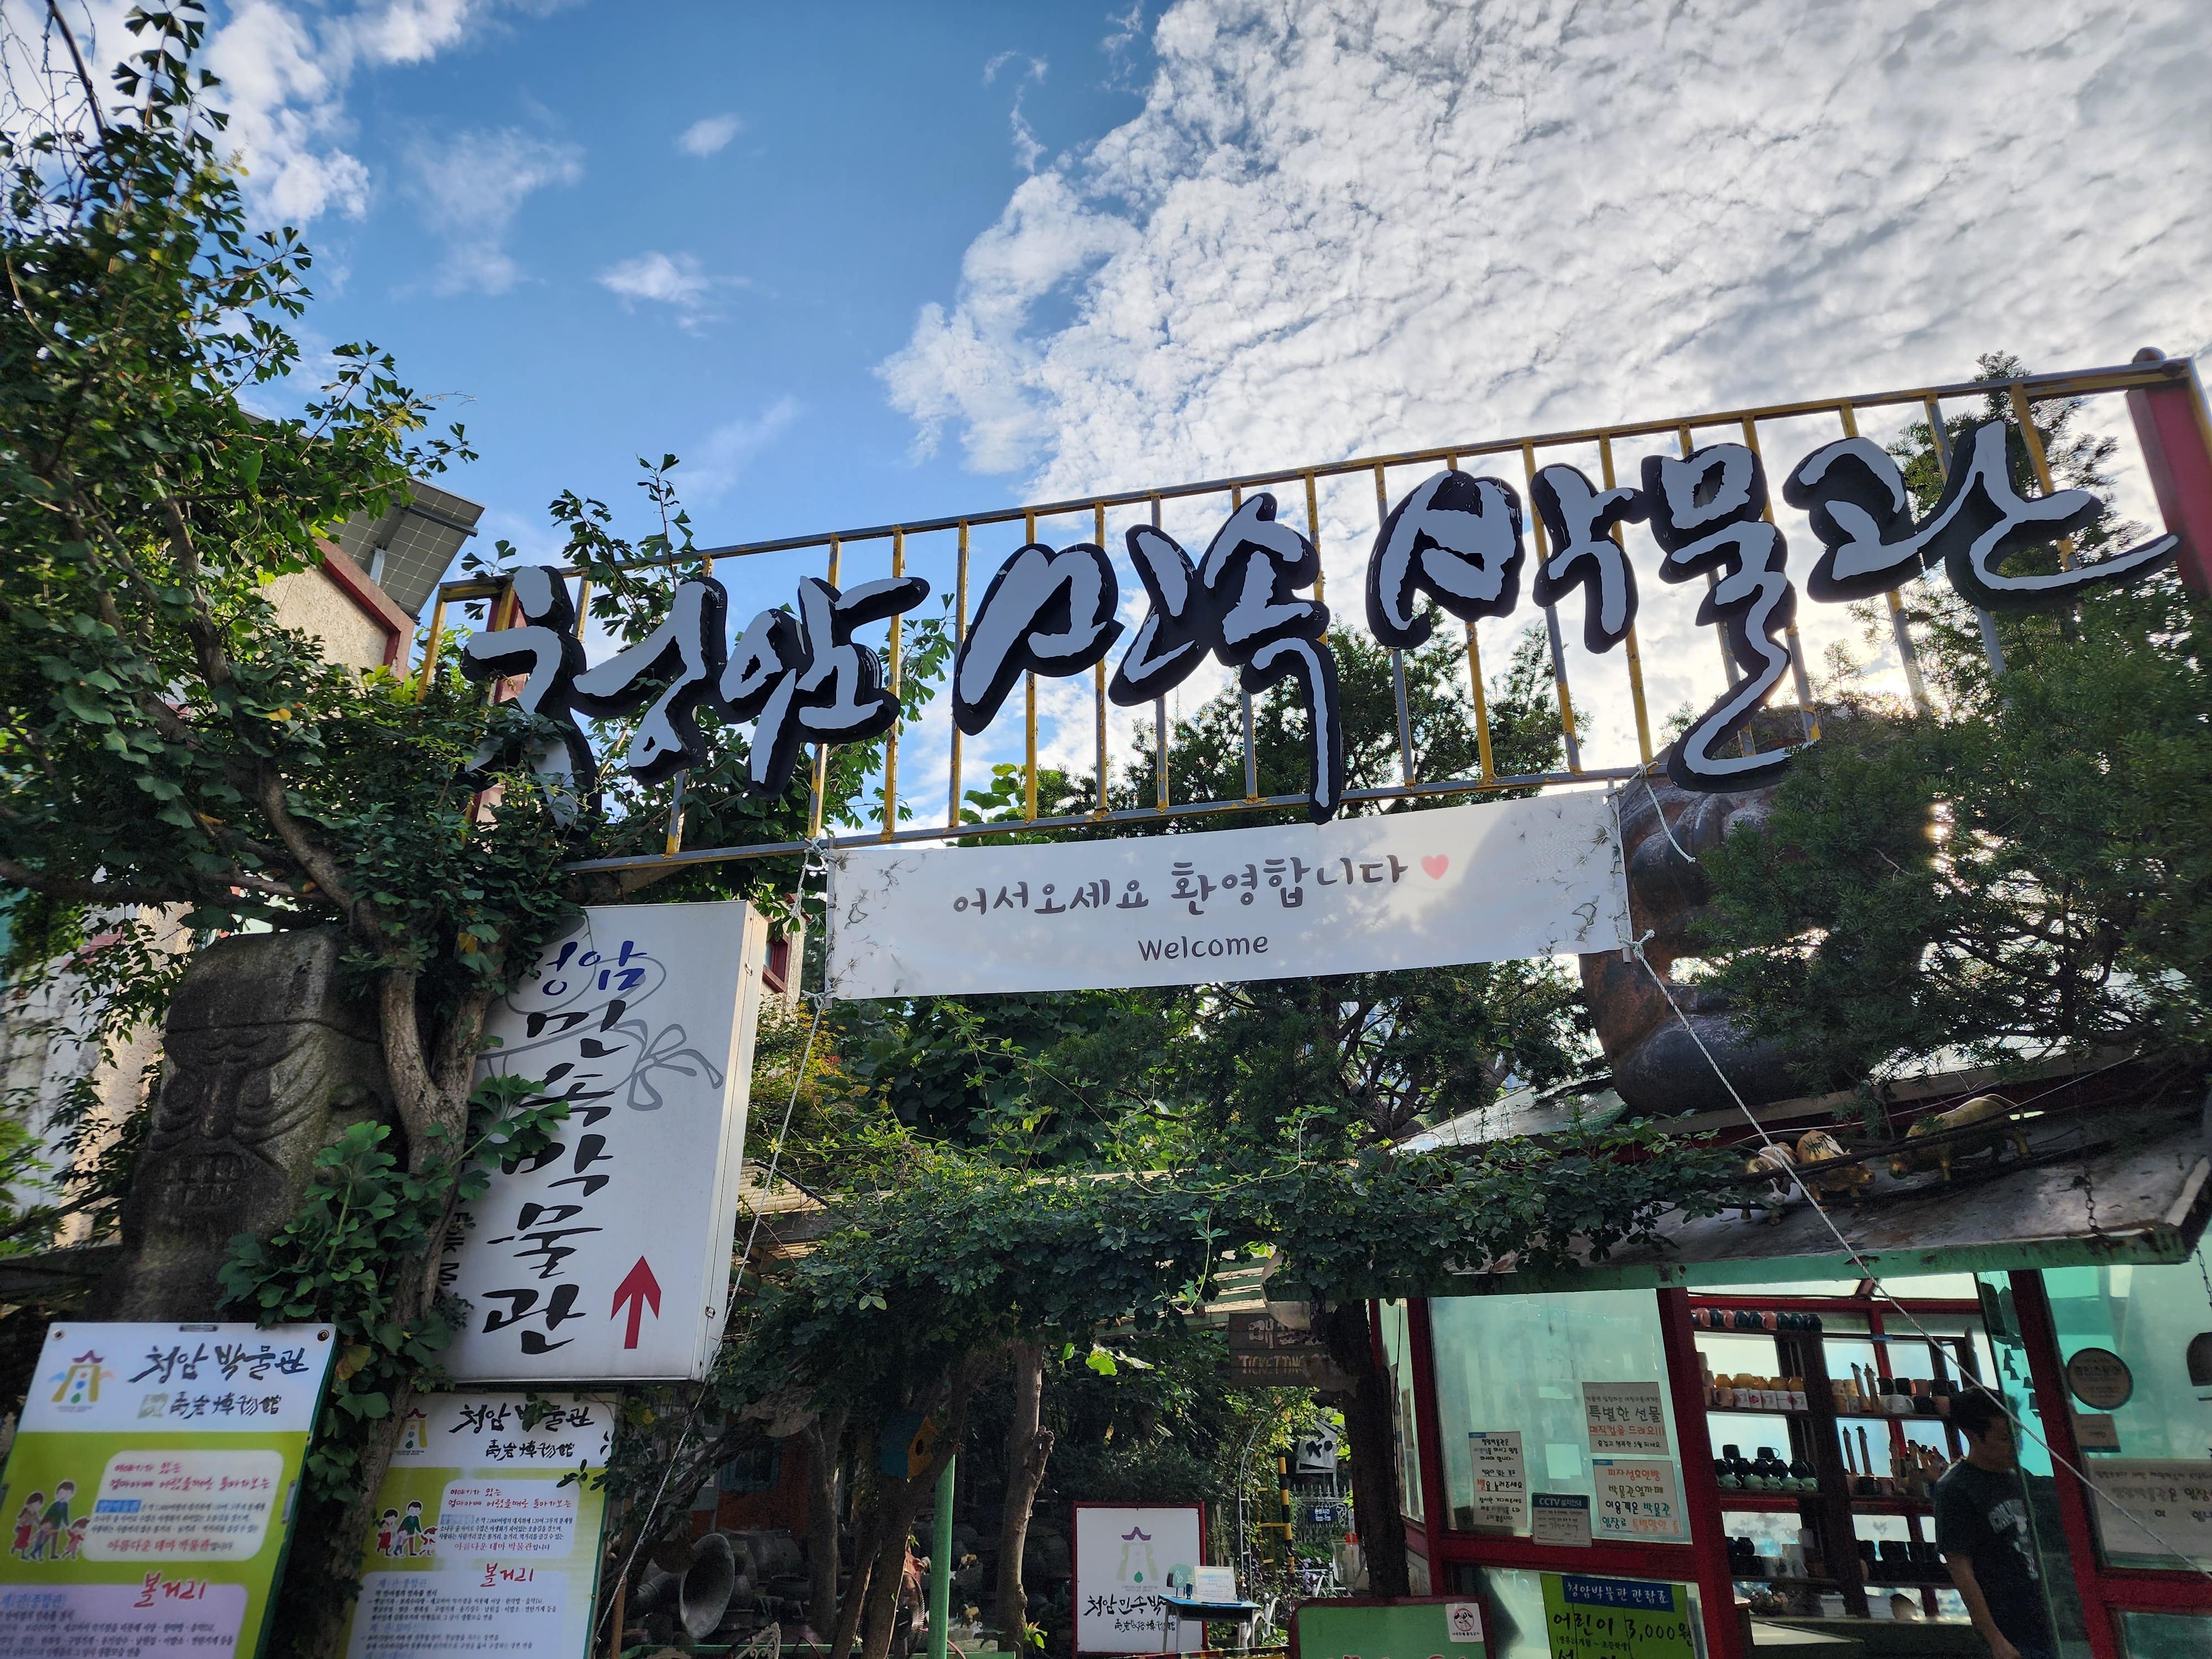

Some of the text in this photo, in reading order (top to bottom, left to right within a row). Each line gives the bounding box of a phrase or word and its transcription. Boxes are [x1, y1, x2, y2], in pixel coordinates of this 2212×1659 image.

[953, 855, 1409, 916] 어서오세요 환영합니다
[1138, 932, 1269, 963] Welcome
[127, 1343, 310, 1384] 청암 박물관
[449, 1402, 511, 1433] 청암
[1589, 1405, 1661, 1423] 특별한 선물
[1539, 1497, 1560, 1506] CCTV
[1644, 1502, 1671, 1516] 박물관
[489, 1542, 506, 1551] 테마
[479, 1563, 534, 1588] 볼거리
[133, 1572, 206, 1608] 볼거리
[1553, 1613, 1614, 1636] 어린이
